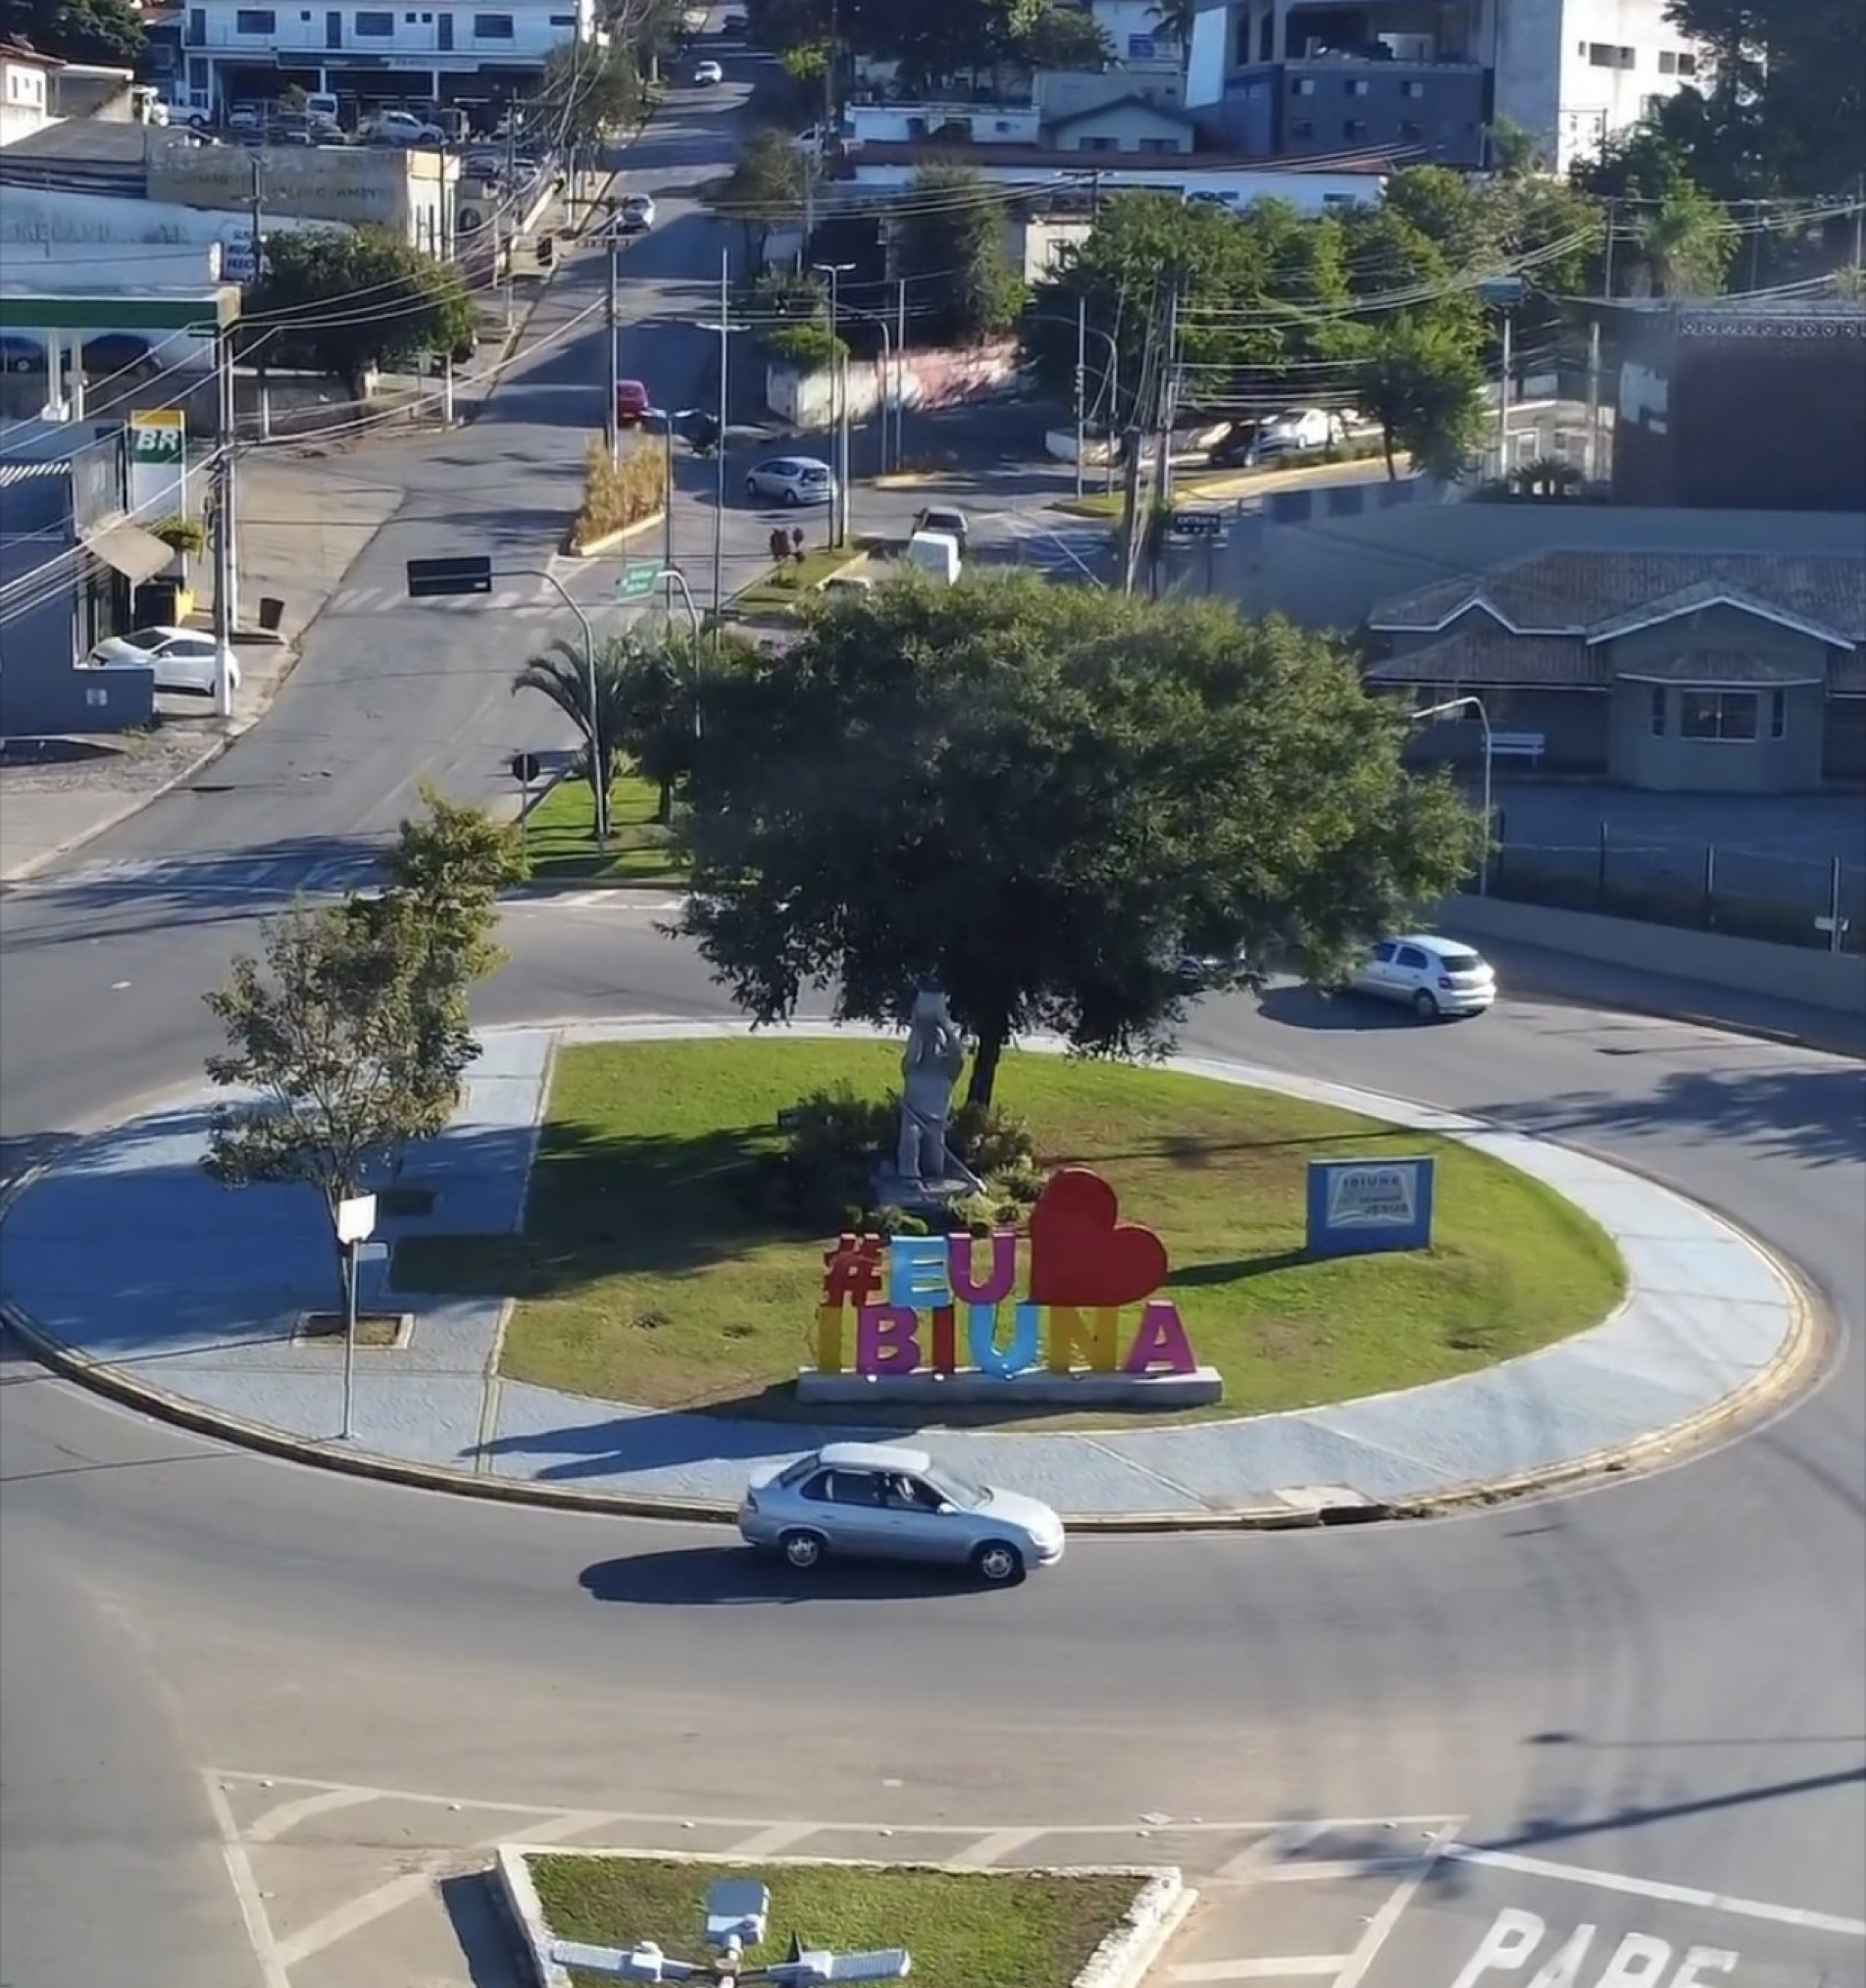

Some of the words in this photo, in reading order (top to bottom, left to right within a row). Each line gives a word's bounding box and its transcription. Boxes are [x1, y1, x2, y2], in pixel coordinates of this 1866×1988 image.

[135, 431, 178, 452] BR
[822, 1231, 1017, 1307] #EU
[818, 1300, 1197, 1376] IBIUNA
